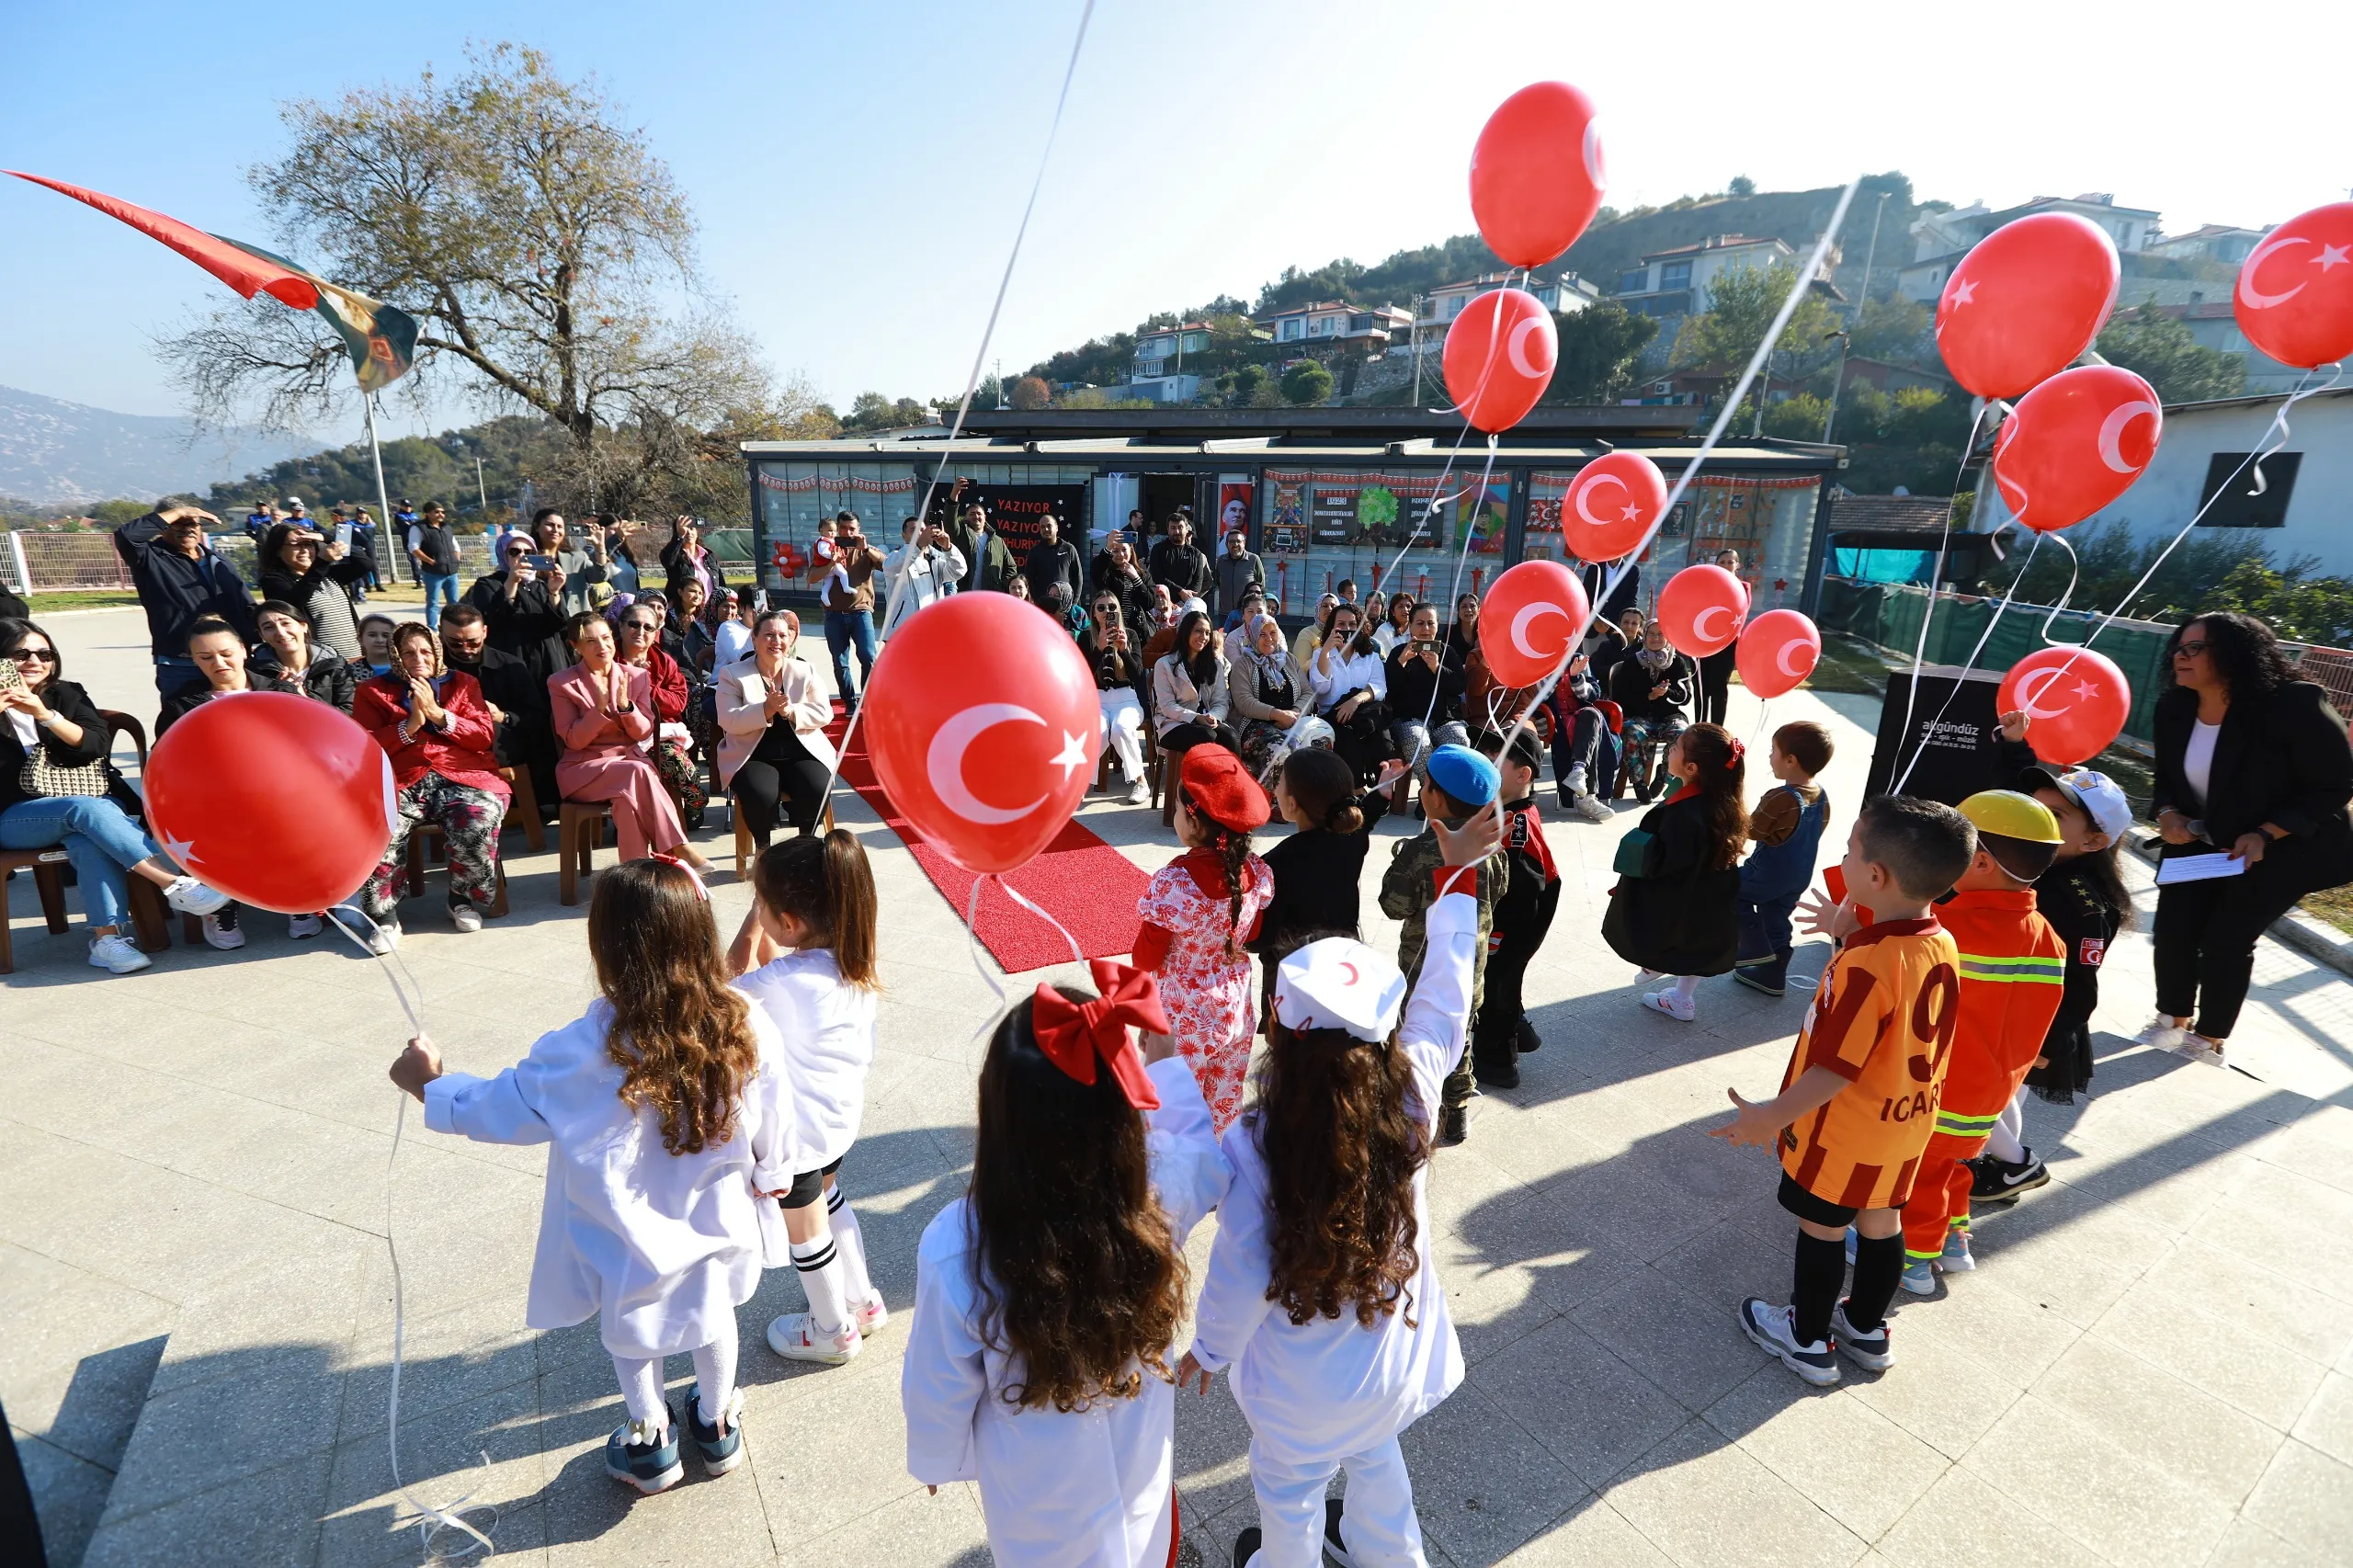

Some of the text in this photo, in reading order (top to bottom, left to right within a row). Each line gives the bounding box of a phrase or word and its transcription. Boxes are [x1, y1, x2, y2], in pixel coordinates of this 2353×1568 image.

[998, 499, 1050, 513] YAZIYOR
[997, 519, 1040, 533] YAZIYO
[1923, 721, 1979, 735] akgündüz
[1908, 962, 1960, 1083] 9
[1880, 1077, 1946, 1123] ICAR
